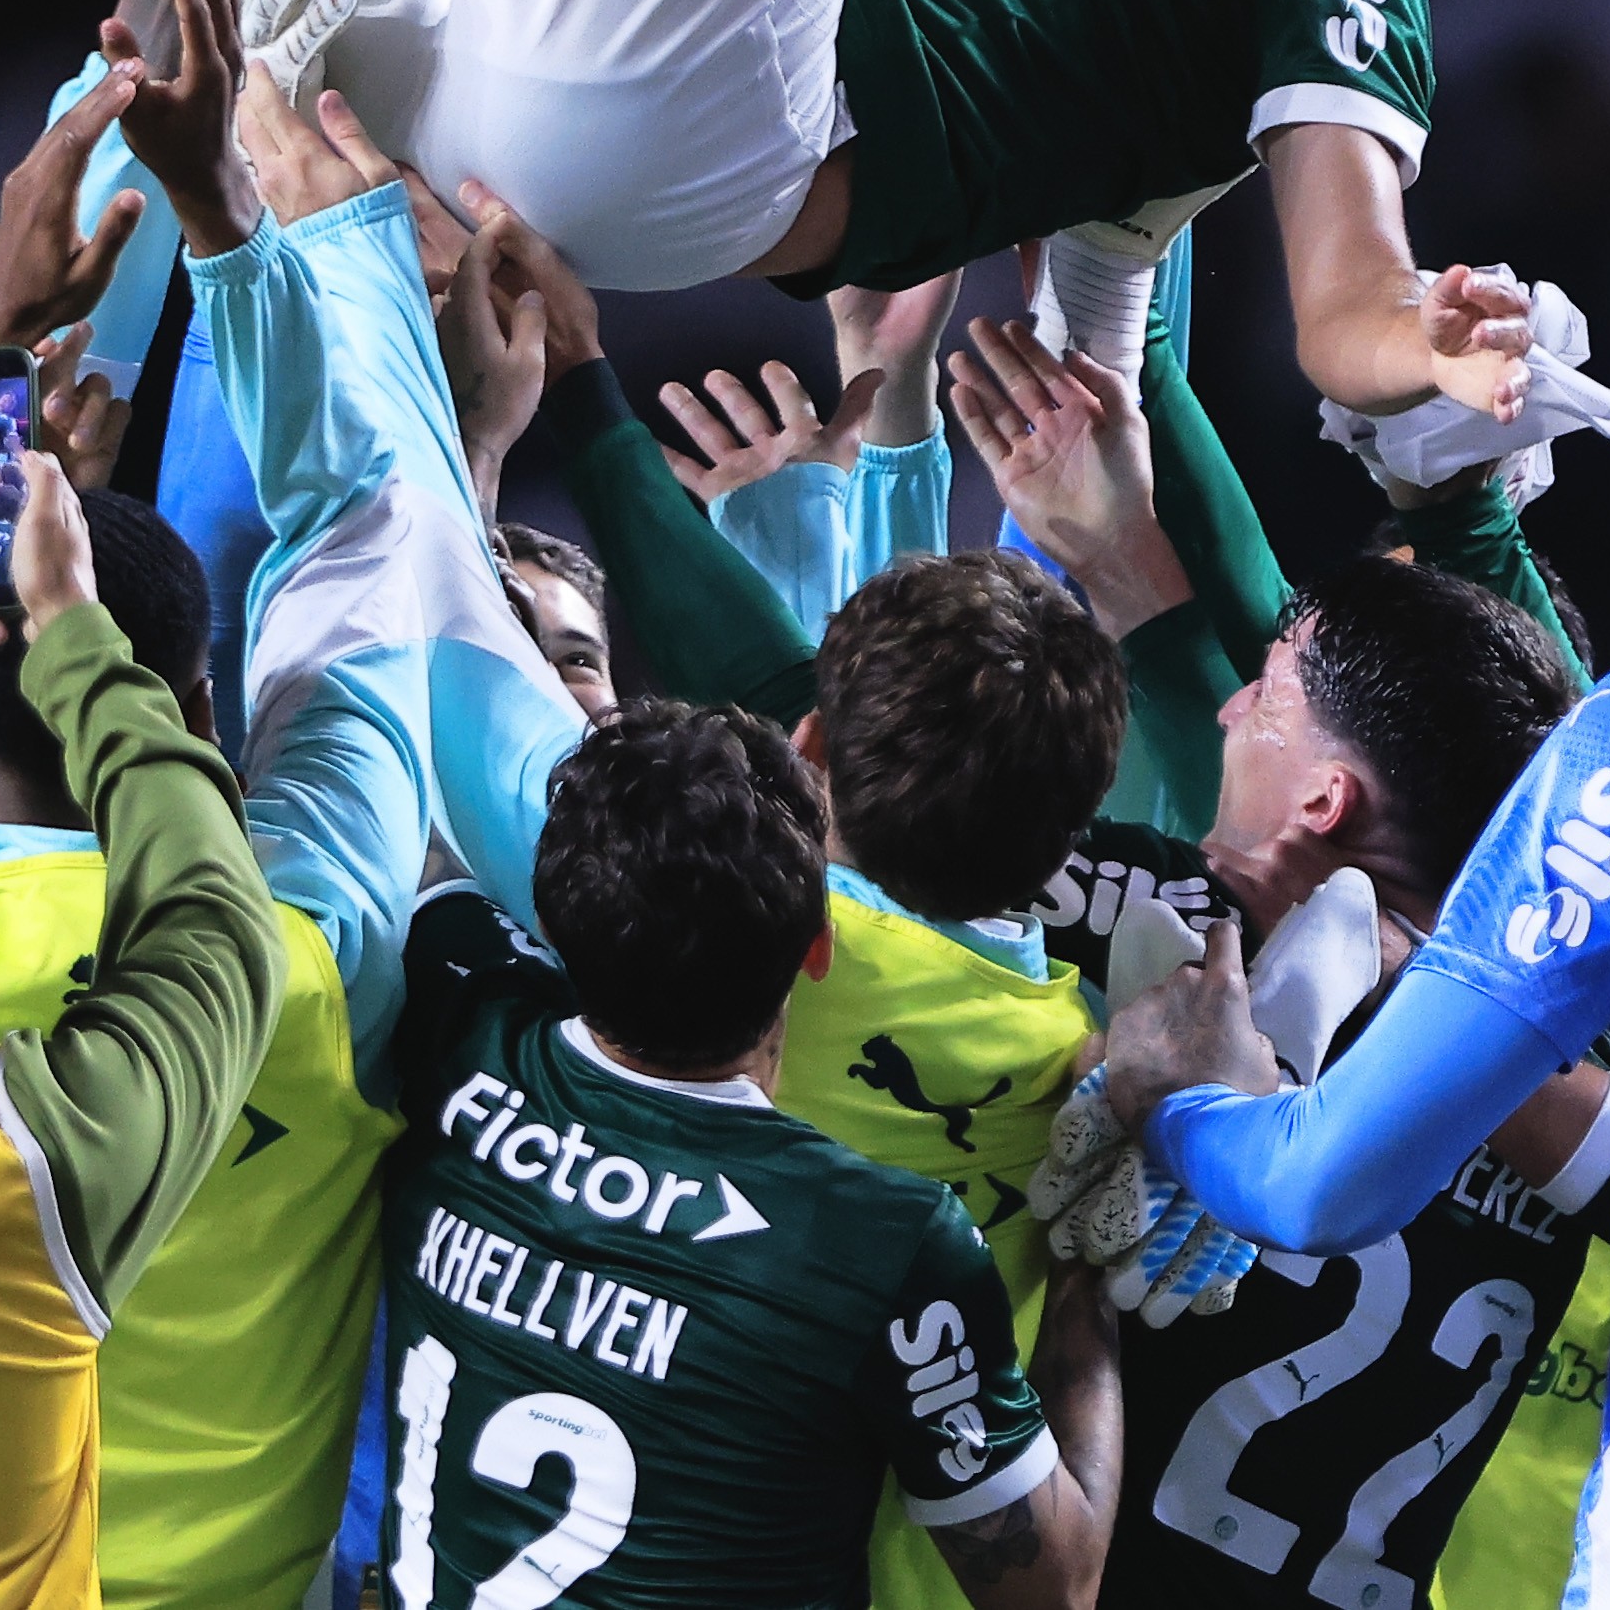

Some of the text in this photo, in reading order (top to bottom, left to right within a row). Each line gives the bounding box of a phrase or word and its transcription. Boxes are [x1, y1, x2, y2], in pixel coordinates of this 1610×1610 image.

[441, 1071, 703, 1234] Fictor
[417, 1206, 688, 1380] KHELLVEN
[390, 1334, 638, 1610] 12
[1153, 1232, 1536, 1610] 22
